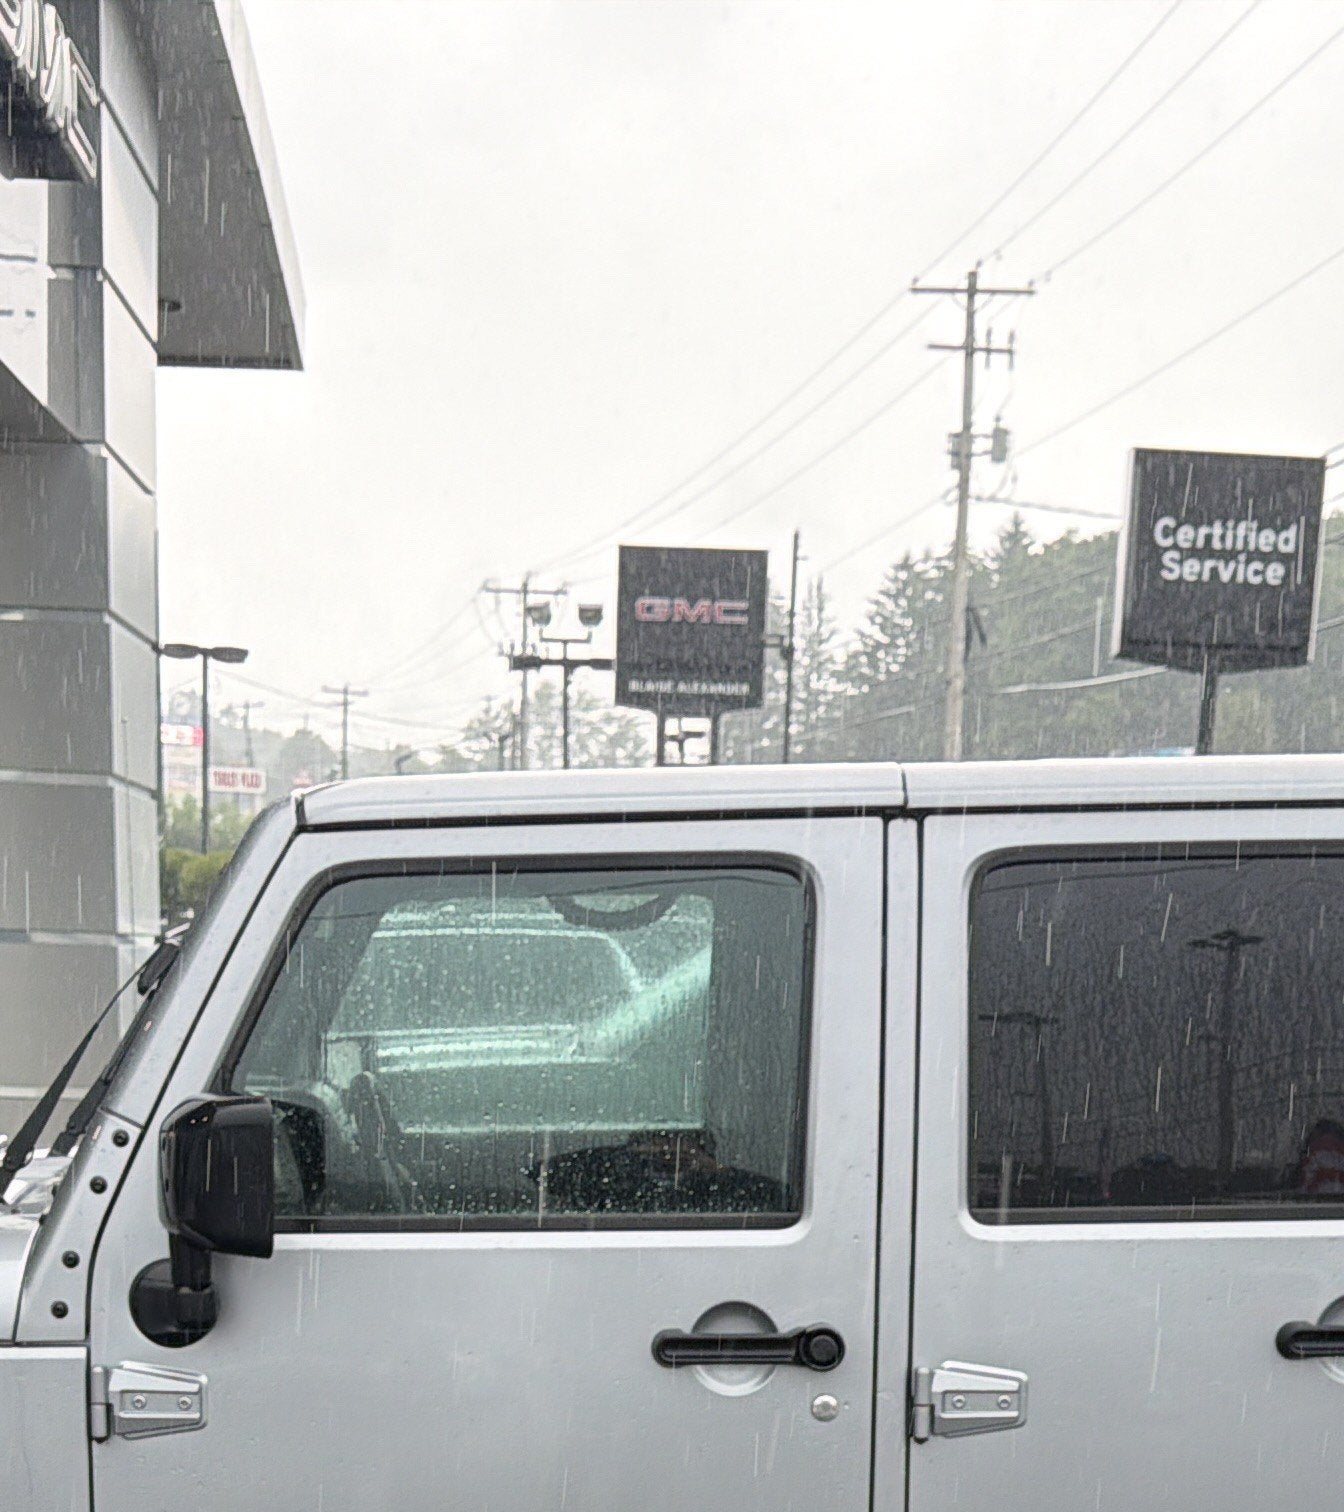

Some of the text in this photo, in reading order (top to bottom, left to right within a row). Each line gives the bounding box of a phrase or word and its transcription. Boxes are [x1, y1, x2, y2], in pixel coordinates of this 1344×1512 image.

[1153, 516, 1298, 554] Certified
[1159, 550, 1286, 586] Service
[634, 596, 750, 625] GMC
